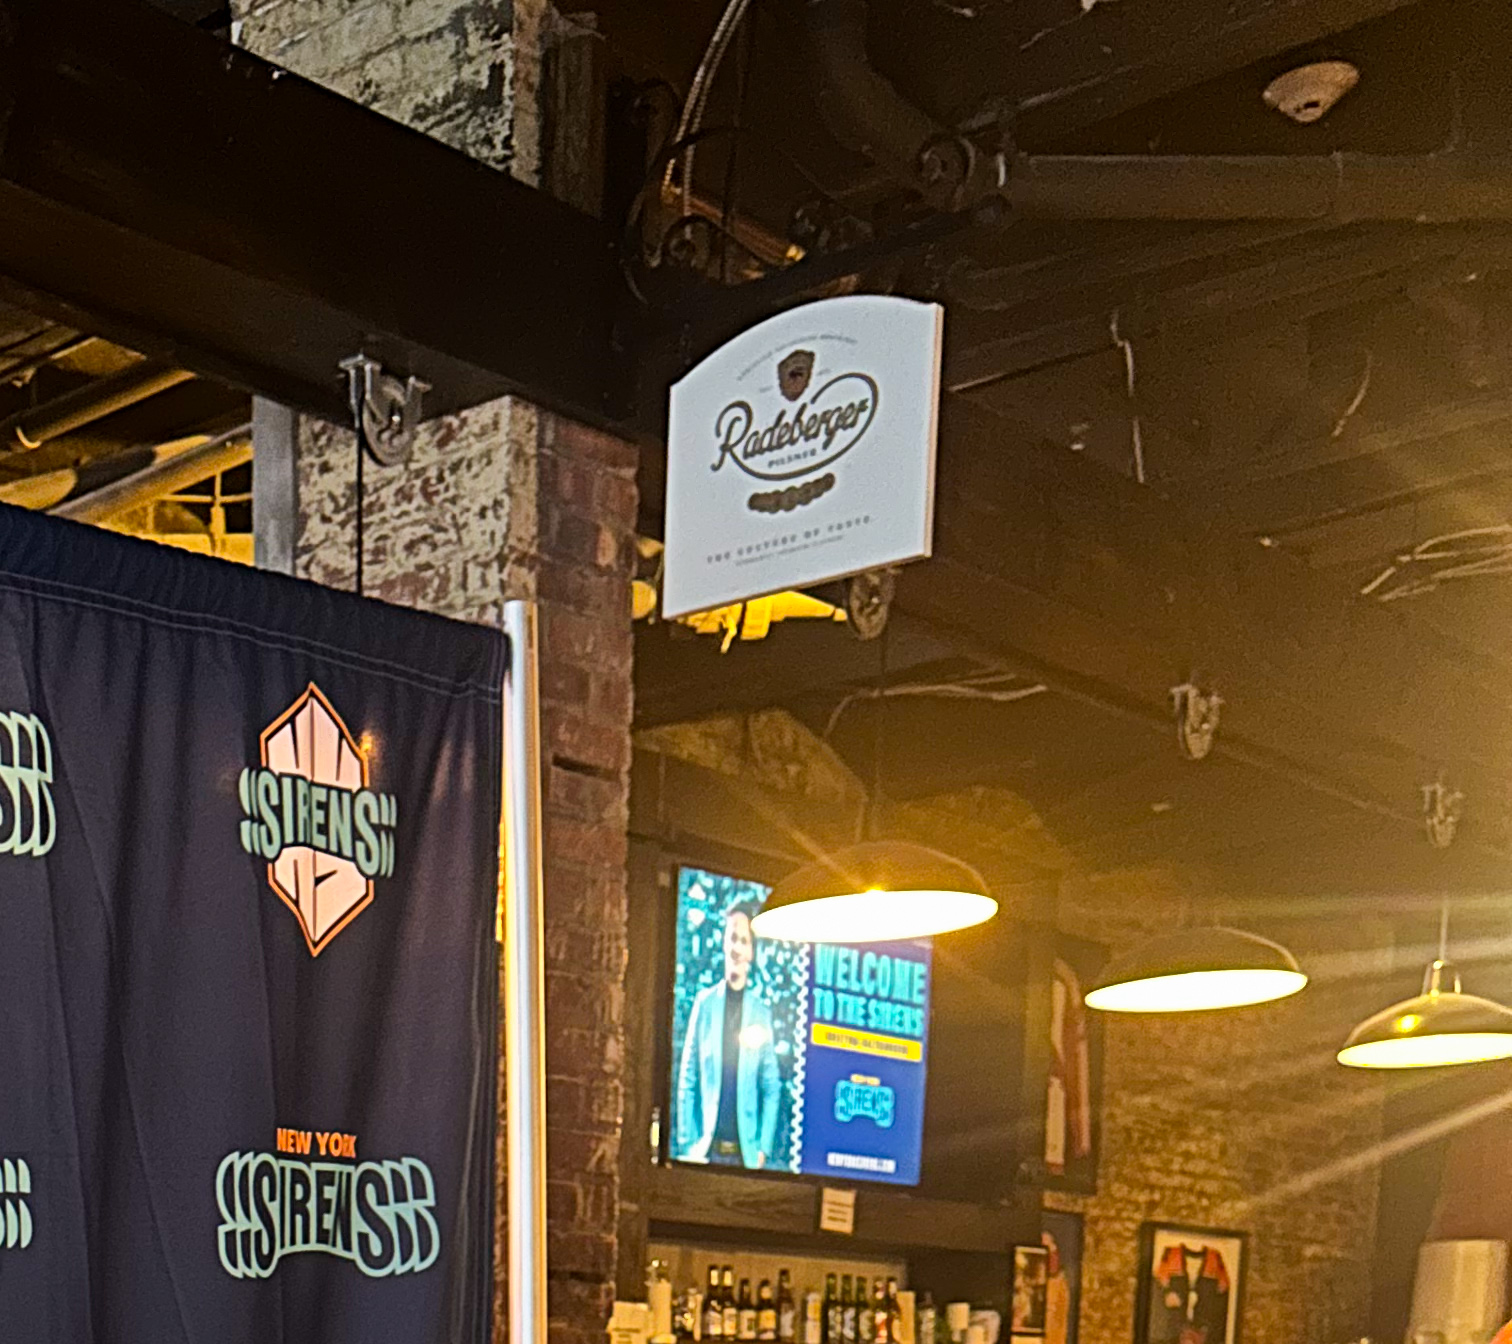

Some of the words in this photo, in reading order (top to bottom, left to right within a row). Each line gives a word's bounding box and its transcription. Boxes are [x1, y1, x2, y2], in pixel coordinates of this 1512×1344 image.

[710, 398, 872, 471] Radeberger
[767, 448, 817, 468] PILSNER
[255, 769, 382, 876] SIRENS
[814, 942, 926, 1004] WELCOME
[276, 1127, 312, 1155] NEW
[315, 1132, 357, 1158] YORK
[216, 1151, 440, 1278] SIRENS
